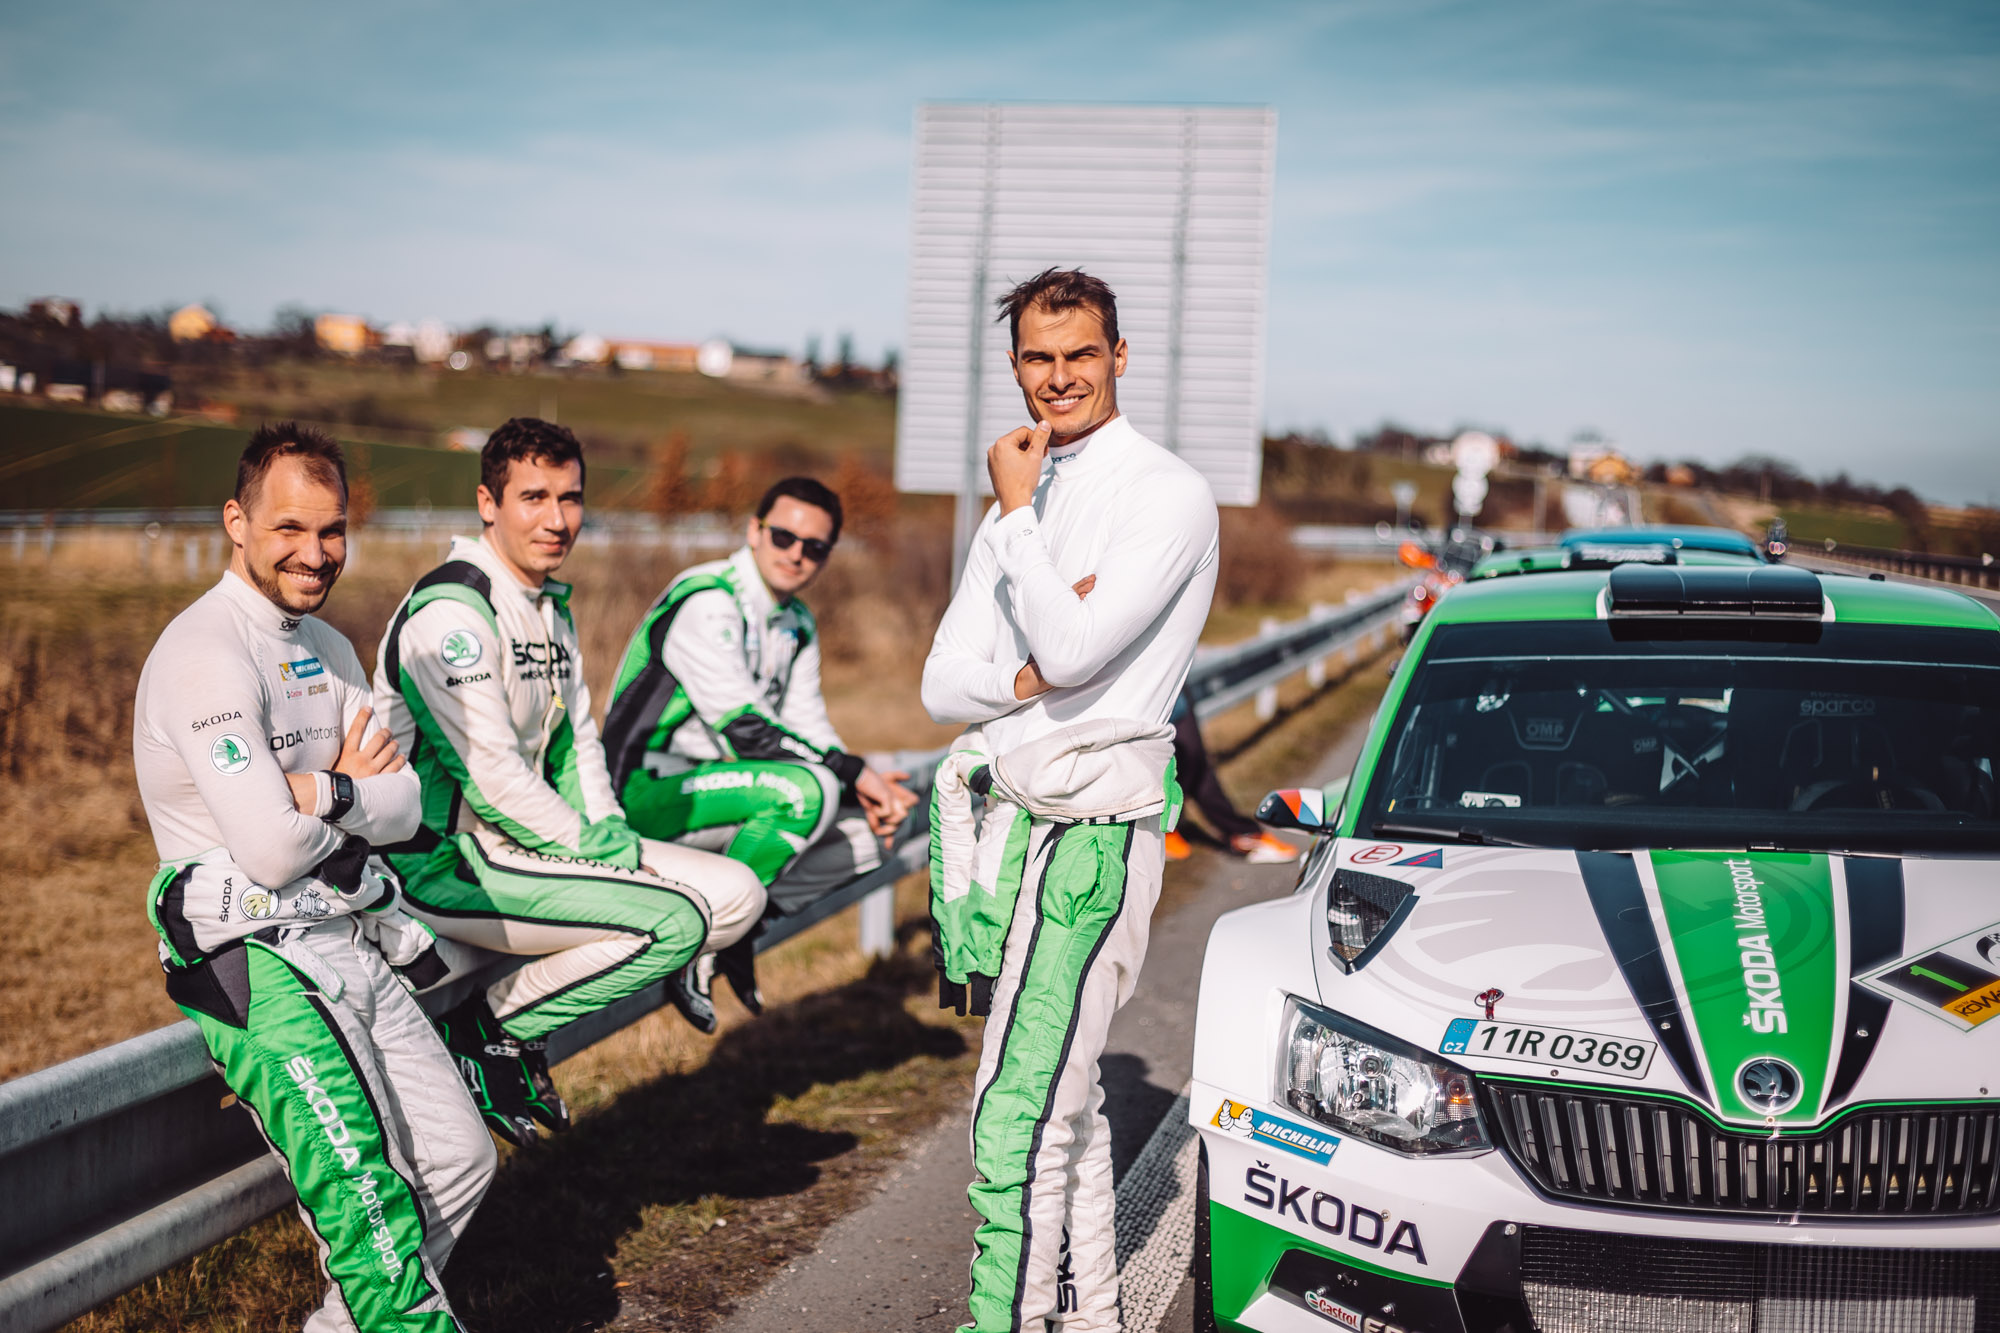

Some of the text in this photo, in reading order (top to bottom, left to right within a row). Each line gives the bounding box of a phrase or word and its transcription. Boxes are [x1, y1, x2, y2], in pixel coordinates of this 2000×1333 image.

[1051, 452, 1077, 464] parco
[191, 711, 243, 733] ŠKODA
[218, 877, 233, 924] ŠKODA
[1723, 858, 1788, 1034] ŠKODA Motorsport
[1909, 964, 1971, 992] 1
[1443, 1041, 1465, 1053] CZ
[1480, 1026, 1646, 1071] 11R 0369
[284, 1055, 360, 1172] ŠKODA
[1257, 1120, 1337, 1155] MICHELIN
[1244, 1160, 1428, 1266] ŠKODA
[1319, 1299, 1357, 1328] Castrol
